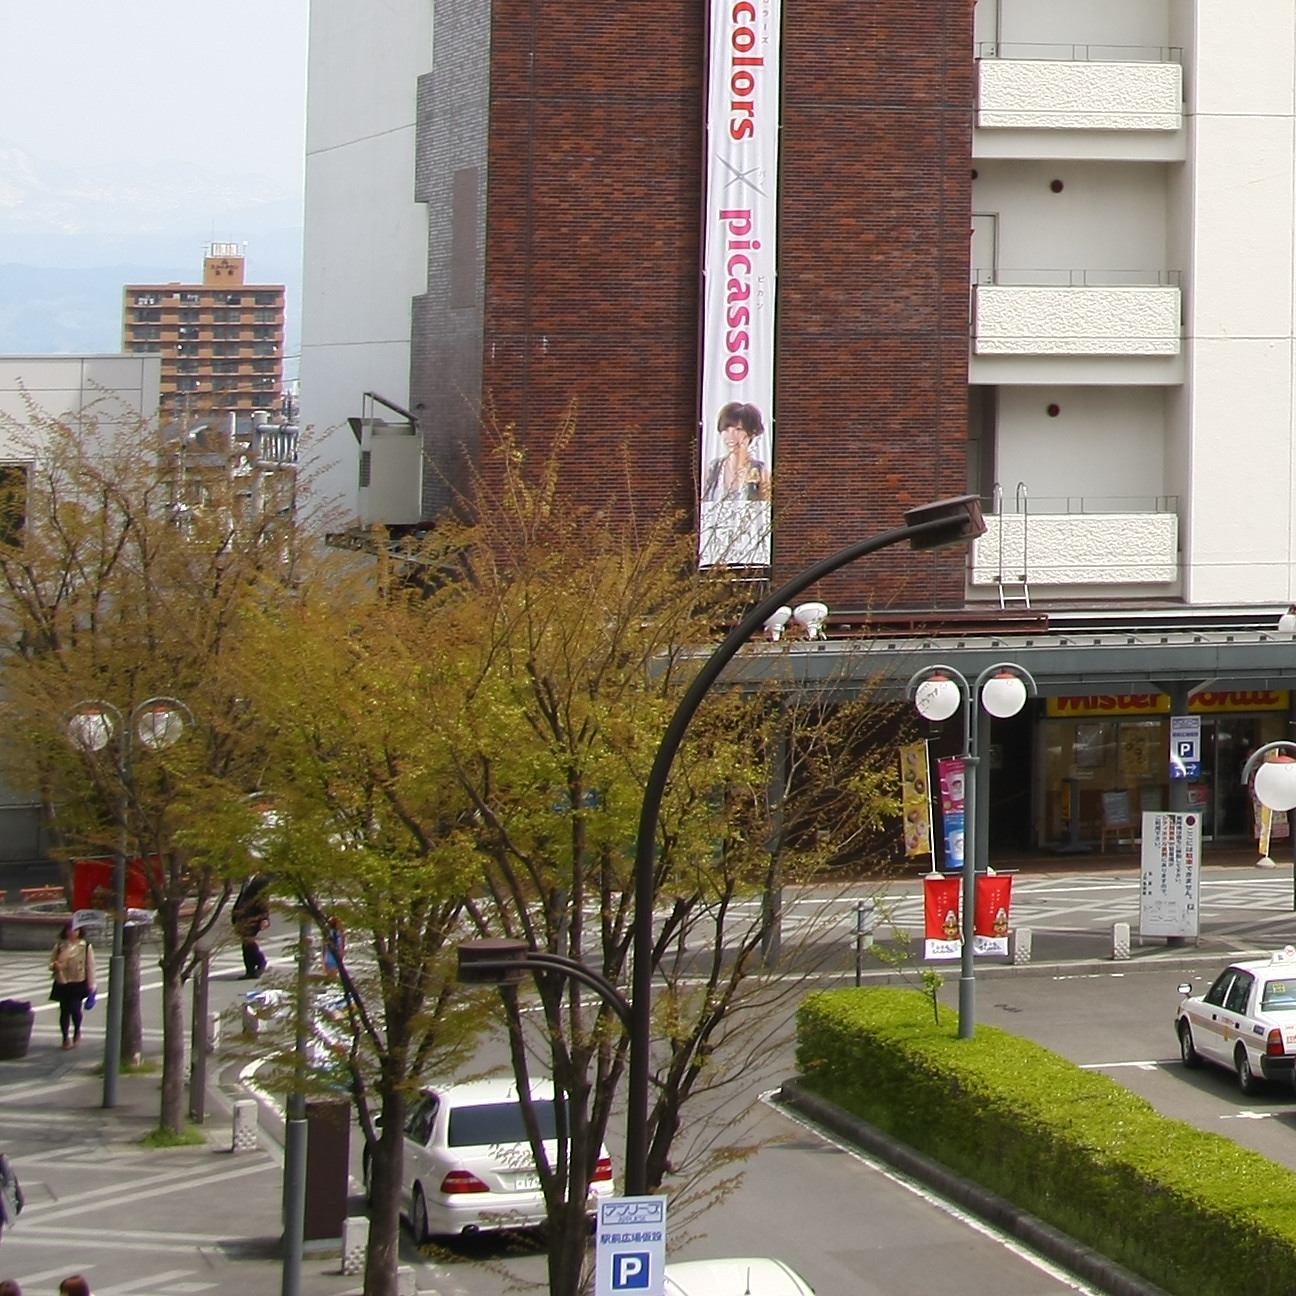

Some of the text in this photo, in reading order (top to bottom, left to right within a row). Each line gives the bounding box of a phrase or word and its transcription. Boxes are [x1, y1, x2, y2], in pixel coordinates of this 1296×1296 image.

[718, 208, 761, 382] picasso
[1180, 743, 1191, 757] P
[620, 1257, 642, 1286] P
